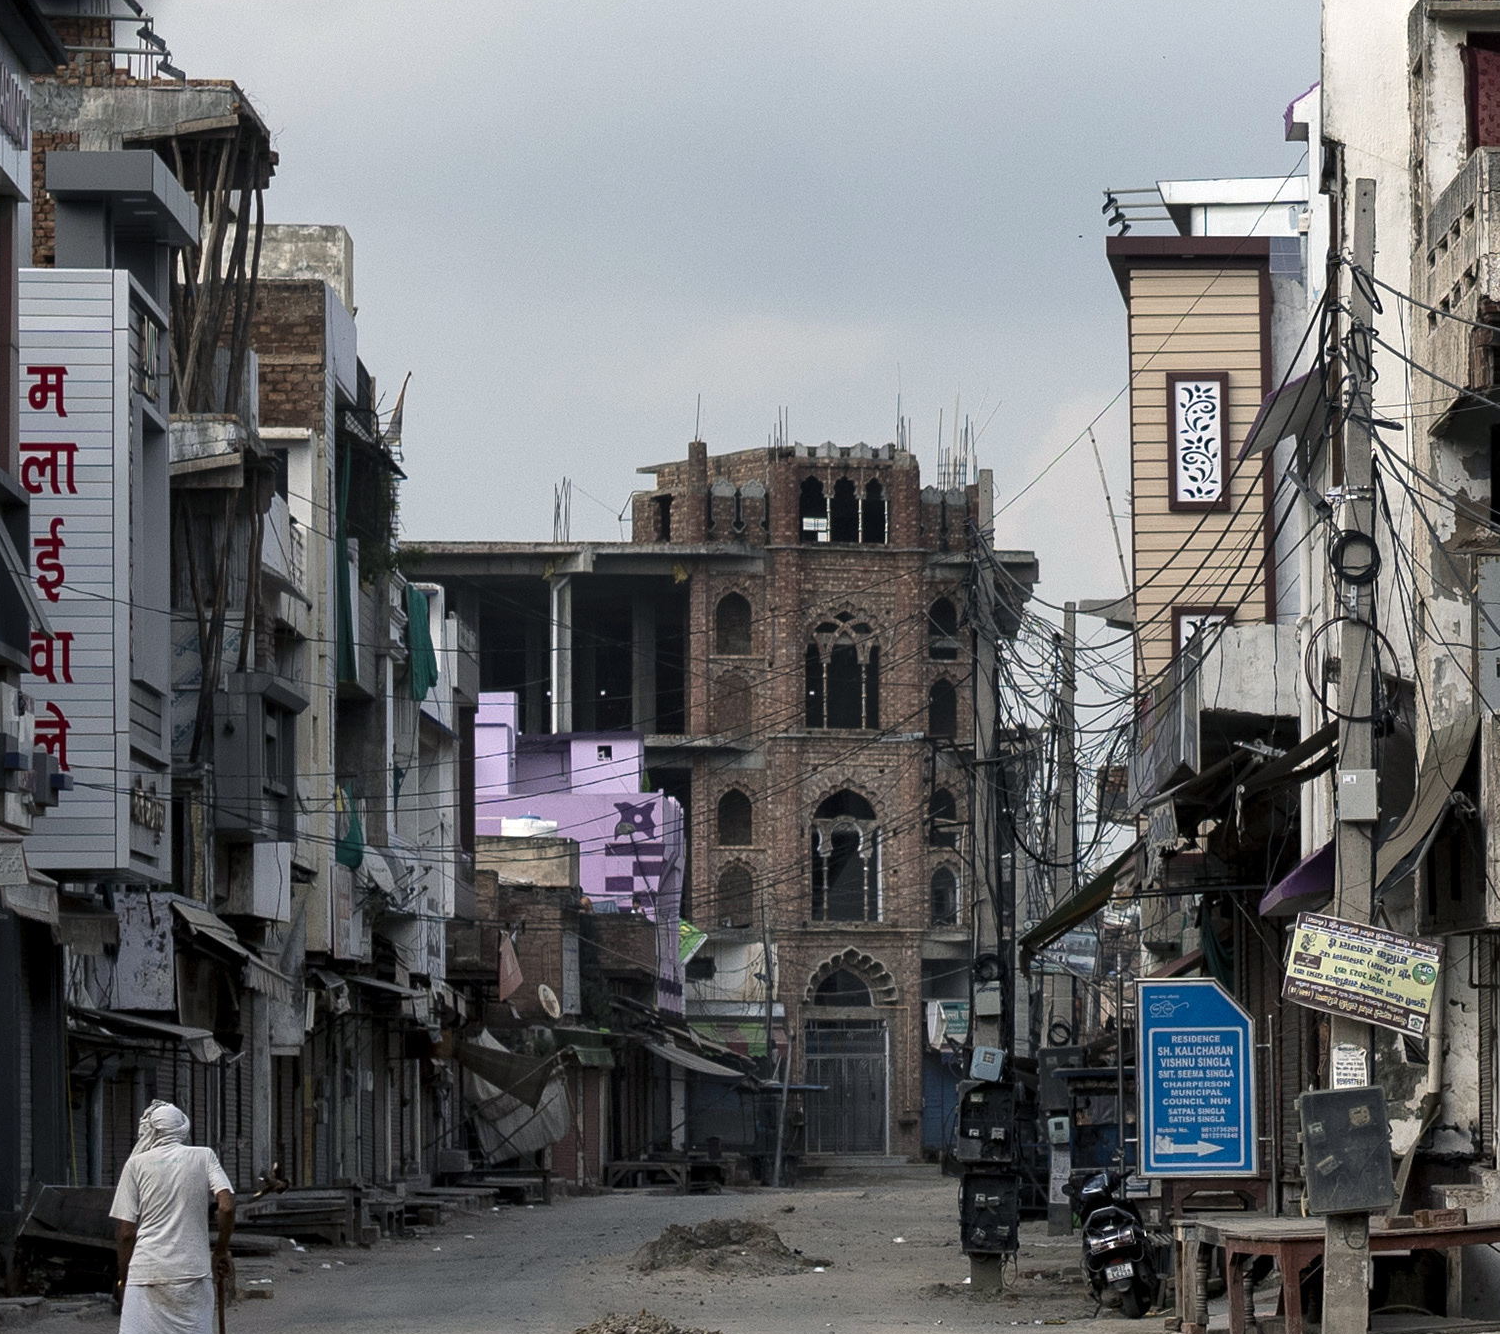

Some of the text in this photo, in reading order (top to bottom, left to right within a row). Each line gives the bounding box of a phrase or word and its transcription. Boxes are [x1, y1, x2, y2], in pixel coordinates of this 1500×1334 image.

[1339, 941, 1374, 956] स्वागत
[1374, 950, 1408, 968] हार्दिक
[1349, 969, 1367, 979] 2023
[1171, 1035, 1221, 1043] RESIDENCE
[1157, 1045, 1234, 1056] SH. KALICHARAN
[1160, 1057, 1231, 1067] VISHNU SINGLA
[1177, 1070, 1204, 1078] SEEMA
[1205, 1069, 1235, 1078] SINGLA
